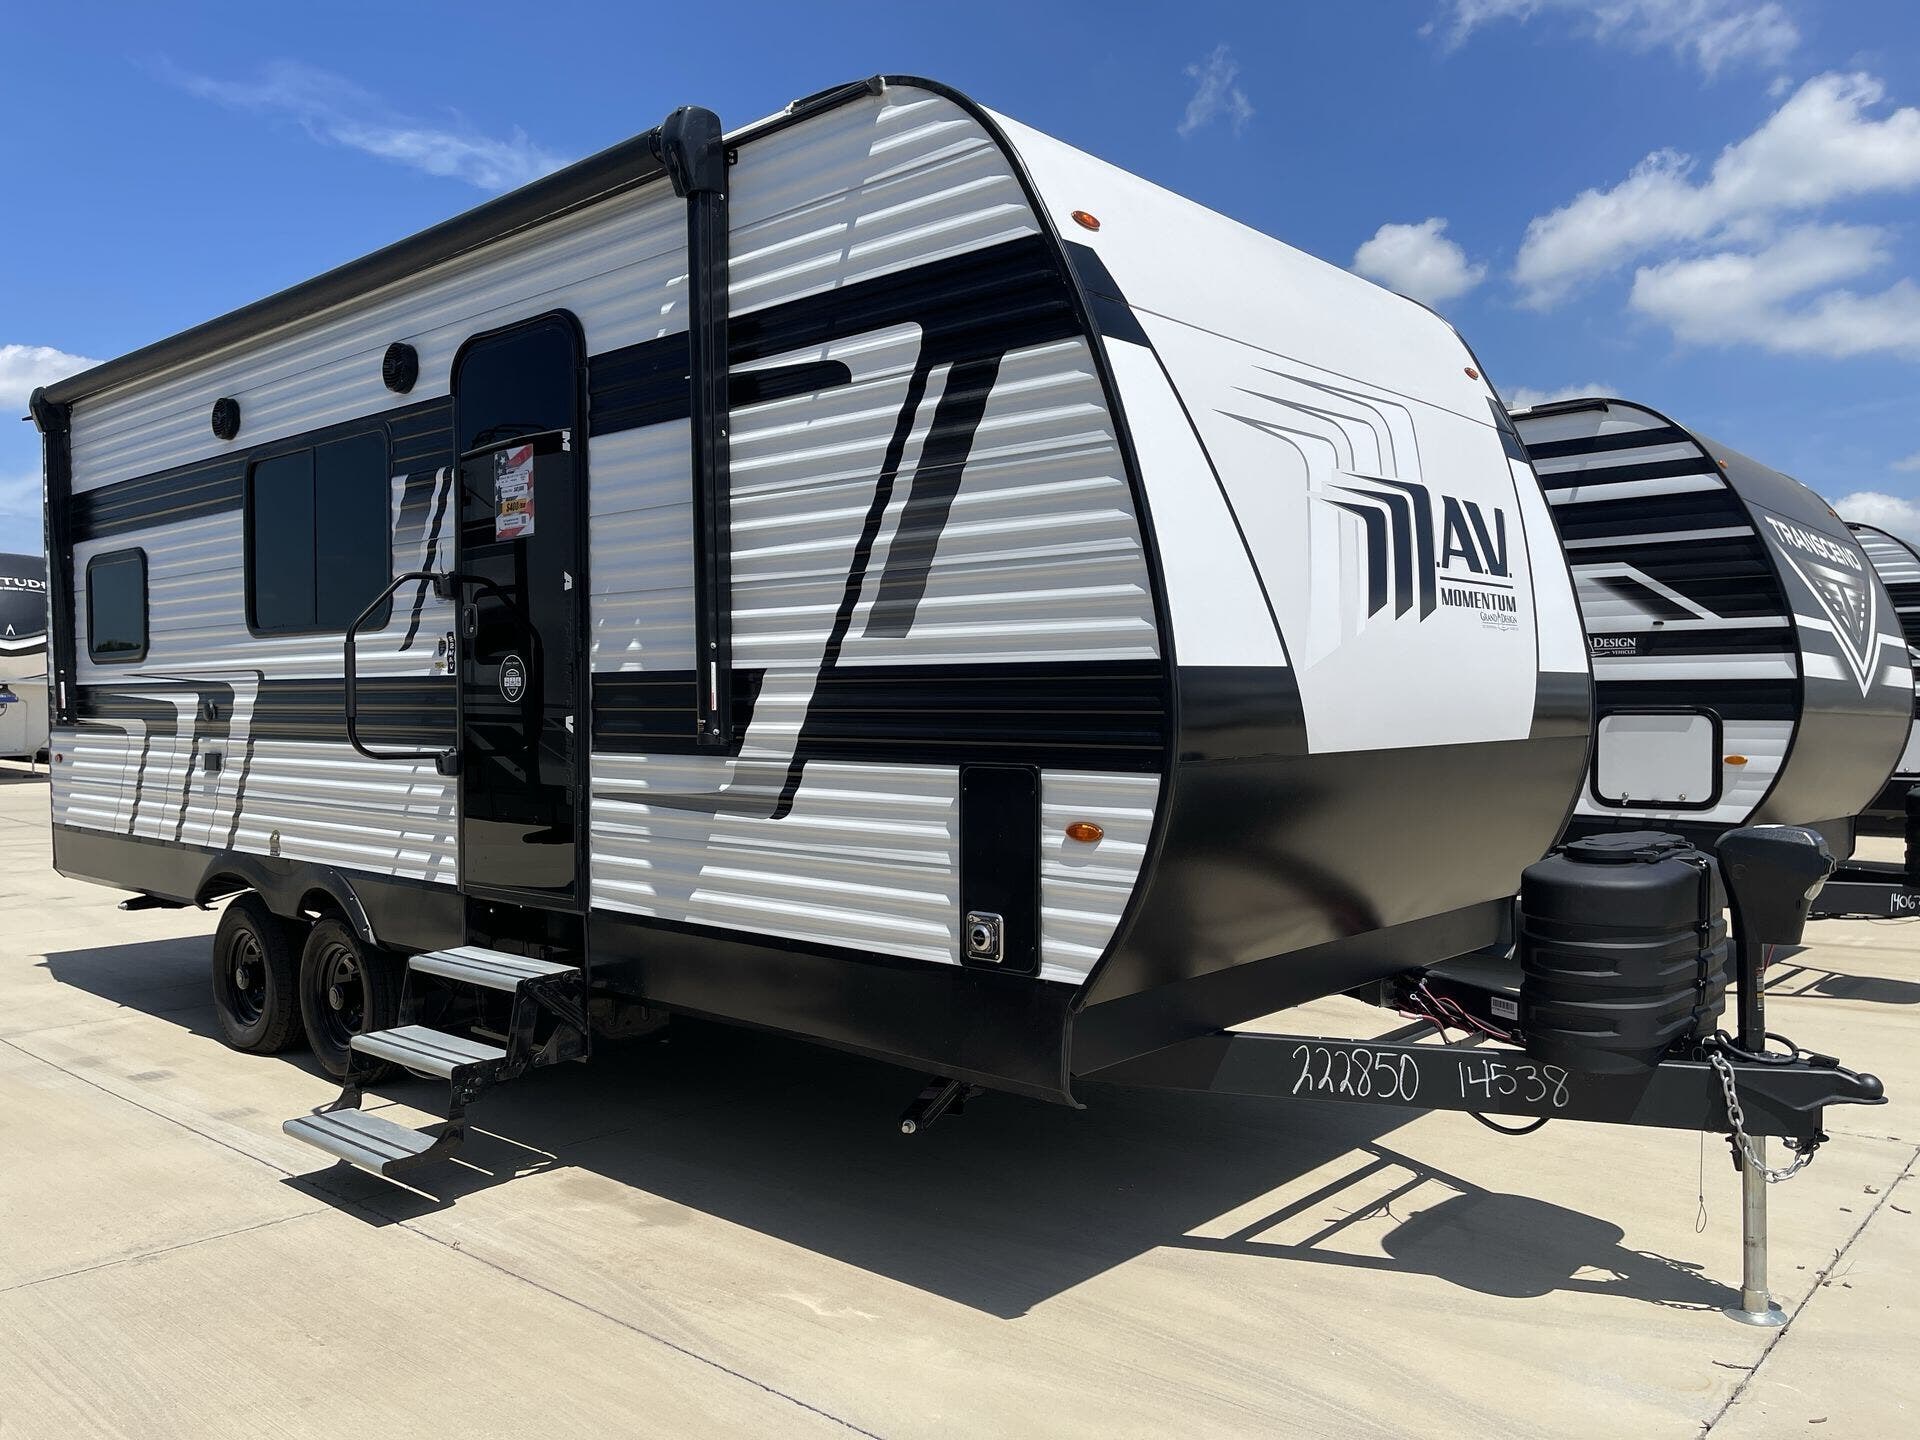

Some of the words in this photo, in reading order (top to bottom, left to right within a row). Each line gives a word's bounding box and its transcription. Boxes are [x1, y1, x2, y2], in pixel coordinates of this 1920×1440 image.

[1765, 516, 1862, 571] TRANSCEND
[1441, 587, 1517, 613] MOMENTUM
[1594, 637, 1636, 648] DESIGN
[1291, 1044, 1420, 1102] 222850
[1457, 1059, 1571, 1108] 14538
